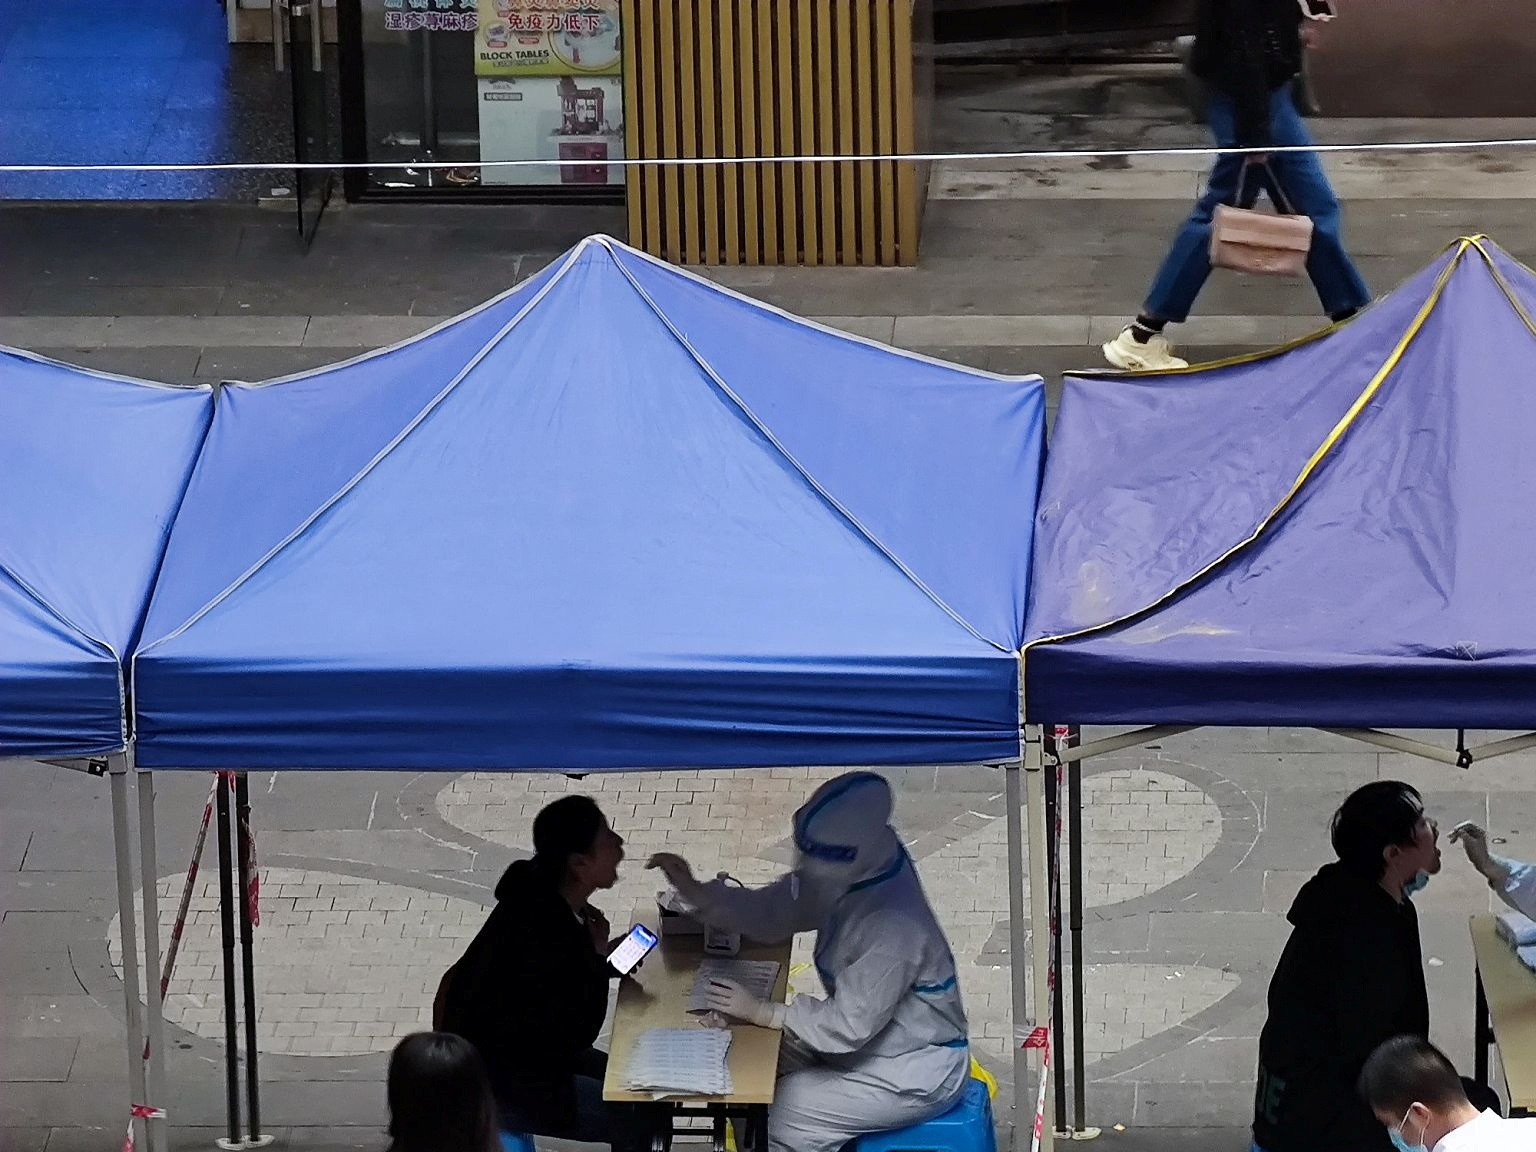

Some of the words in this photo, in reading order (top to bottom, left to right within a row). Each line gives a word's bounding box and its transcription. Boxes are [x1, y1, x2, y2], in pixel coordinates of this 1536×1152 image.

[508, 13, 600, 31] 免疫力低下
[480, 52, 513, 60] BLOCK
[515, 49, 550, 59] TABLES
